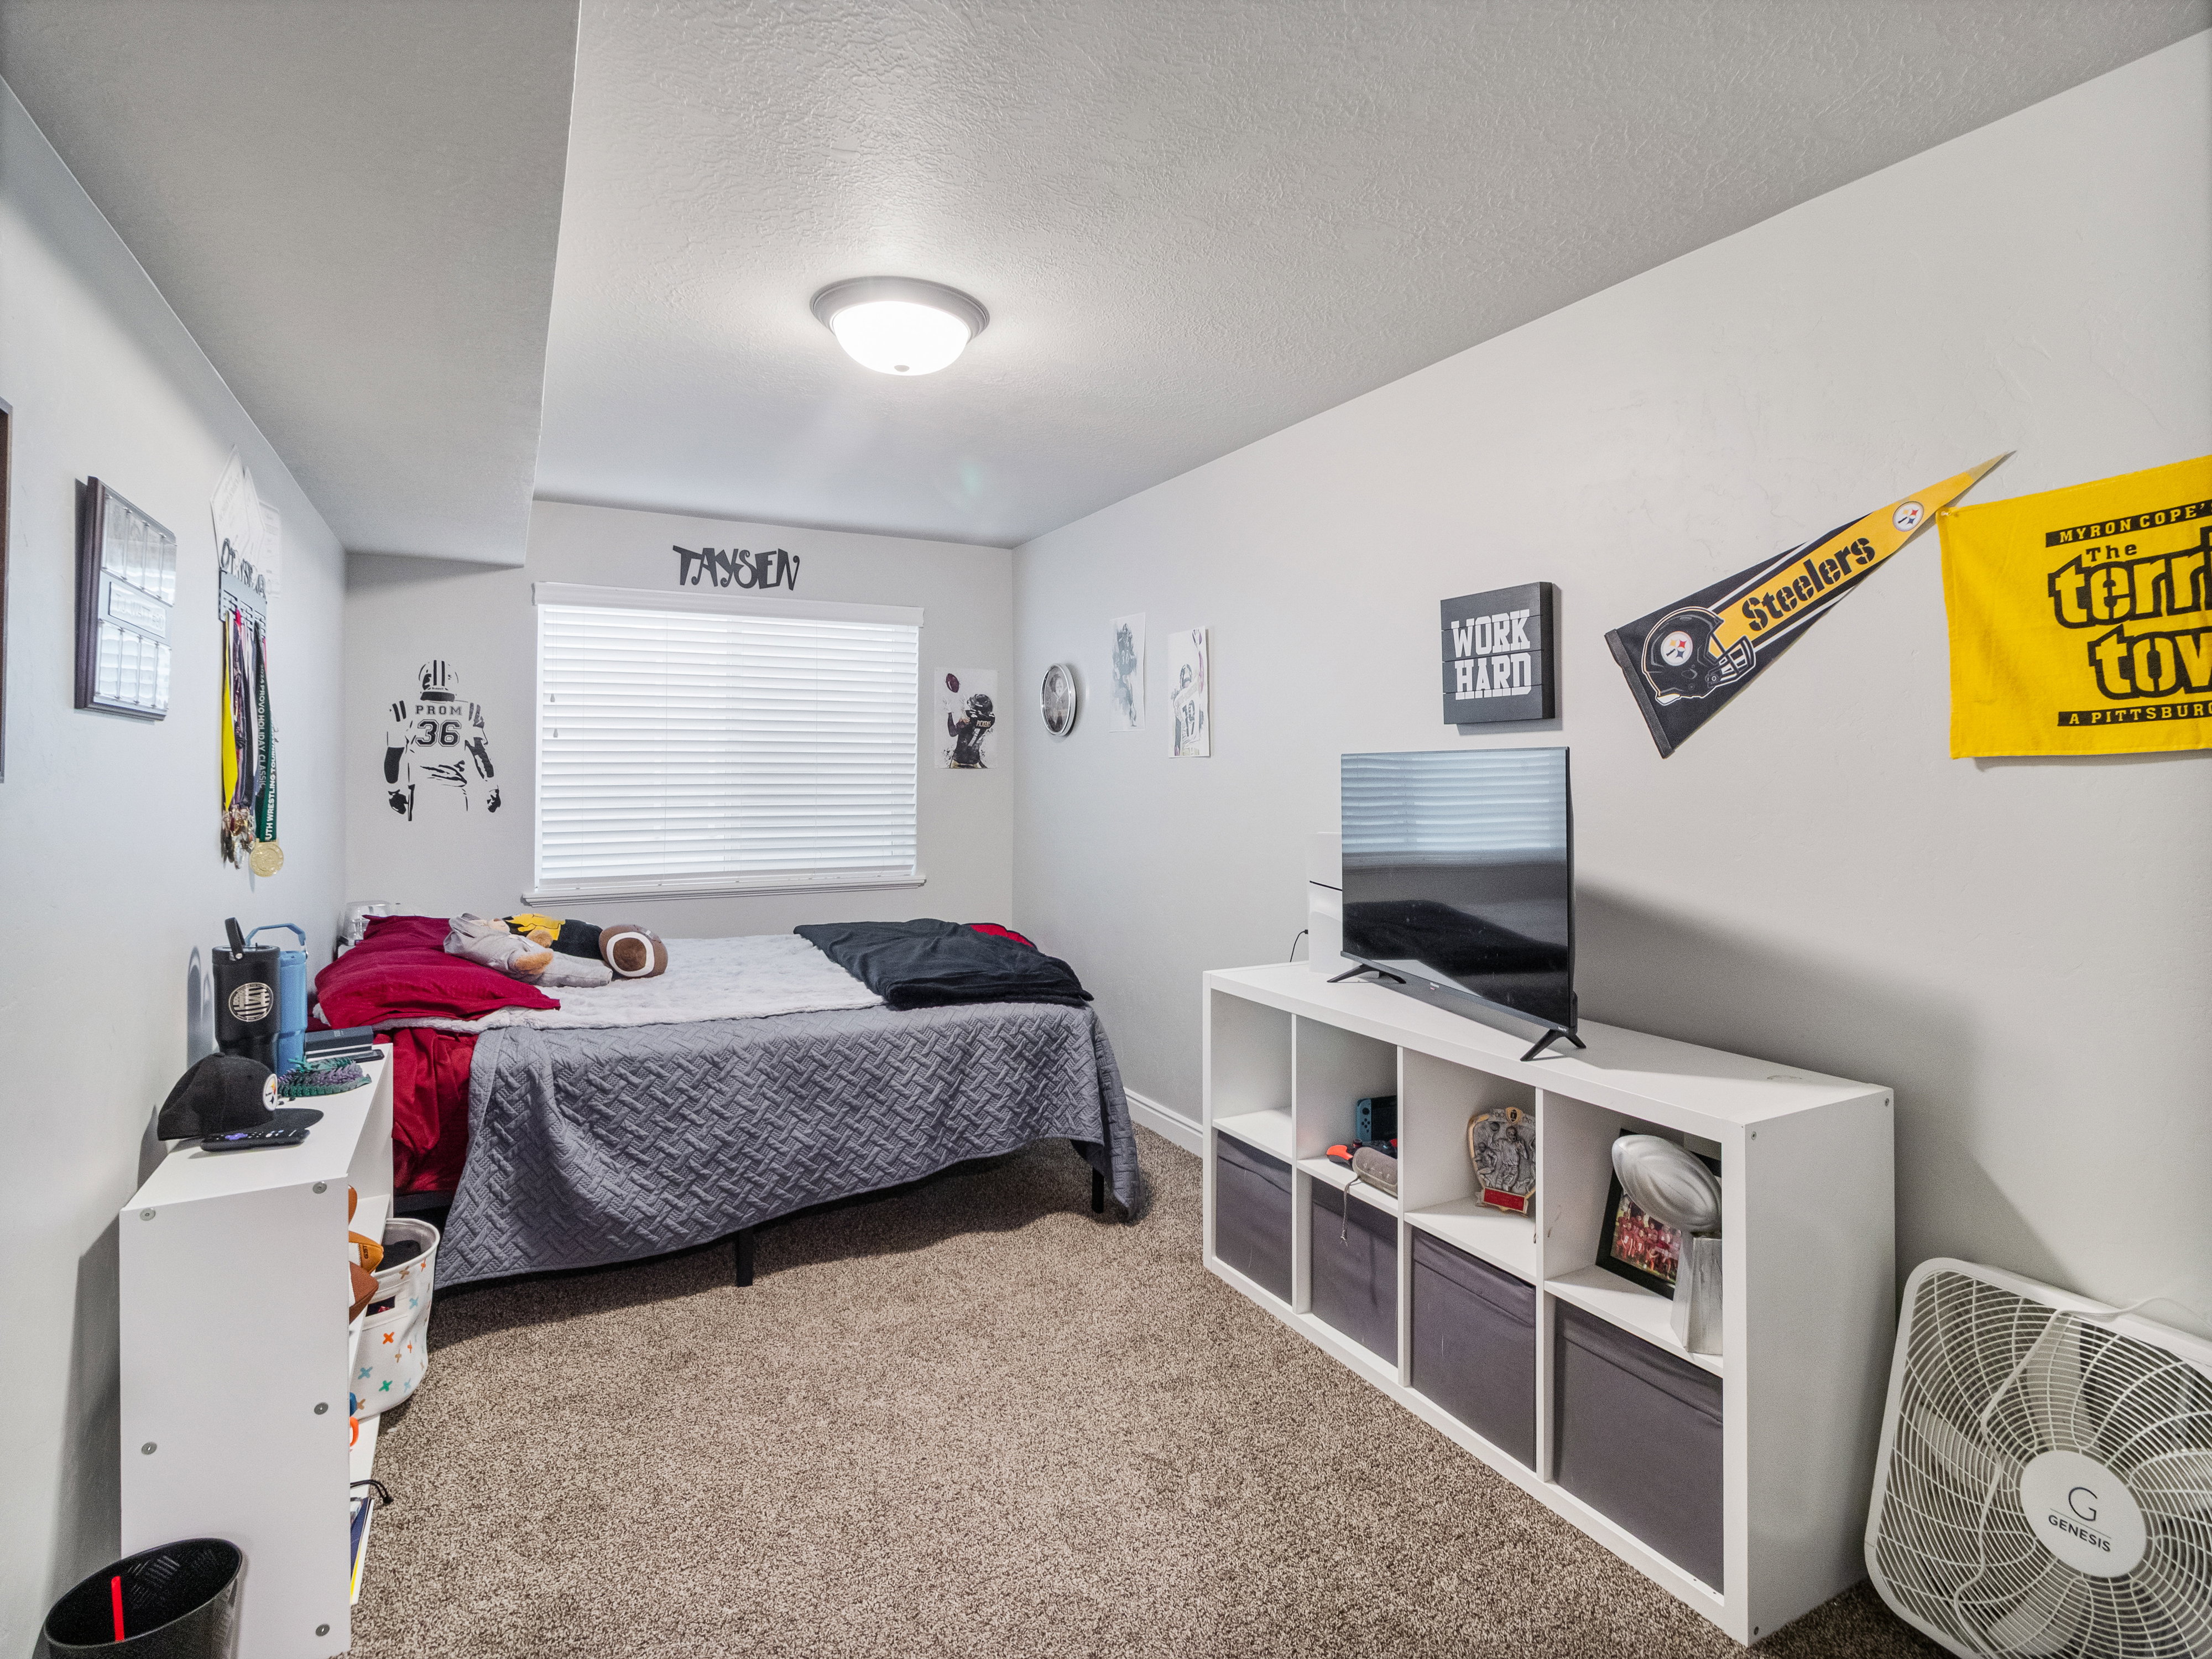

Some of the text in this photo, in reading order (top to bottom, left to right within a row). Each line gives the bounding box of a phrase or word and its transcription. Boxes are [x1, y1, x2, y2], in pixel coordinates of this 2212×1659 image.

[2059, 502, 2212, 544] MYRON COPE'
[672, 545, 800, 591] TAYSEN
[2086, 544, 2137, 562] The
[1741, 537, 1876, 632] Steelers
[2048, 526, 2212, 629] terr
[1451, 608, 1531, 658] WORK
[1454, 652, 1532, 700] HARD
[416, 705, 462, 716] PROM
[2069, 713, 2080, 724] A
[415, 719, 462, 747] 36
[266, 774, 276, 822] WRESTLING
[265, 822, 273, 841] UTH
[2068, 1486, 2098, 1522] G
[2048, 1514, 2111, 1552] GENESIS
